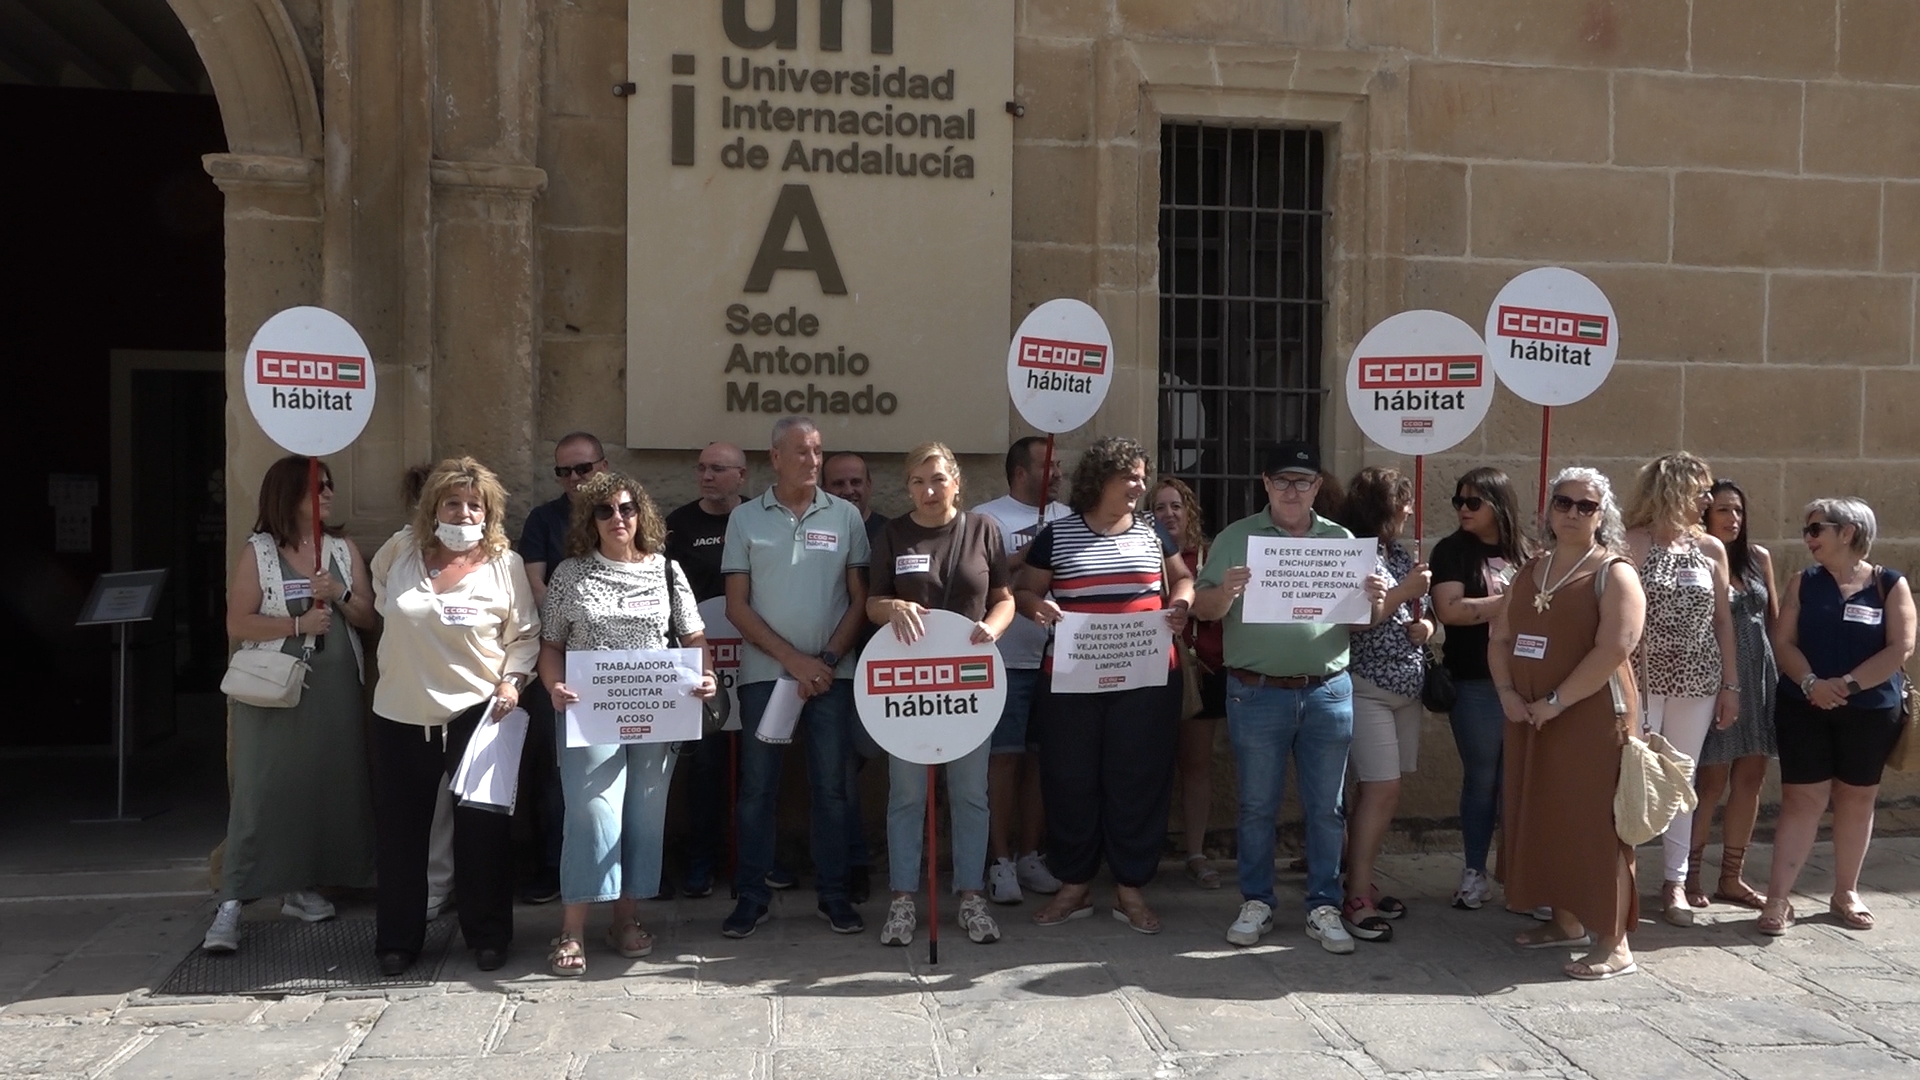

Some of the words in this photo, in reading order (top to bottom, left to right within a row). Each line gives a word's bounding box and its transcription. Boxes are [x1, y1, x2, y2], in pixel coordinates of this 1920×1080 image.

[722, 56, 954, 101] Universidad
[672, 54, 695, 166] i
[722, 96, 976, 140] Internacional
[721, 137, 769, 169] de
[781, 139, 975, 179] Andalucía
[743, 183, 848, 295] A
[725, 303, 820, 337] Sede
[1503, 312, 1574, 337] CCOO
[724, 343, 870, 376] Antonio
[1022, 343, 1081, 366] CCOO
[1509, 339, 1592, 366] hábitat
[262, 358, 333, 380] CCOO
[1364, 362, 1443, 382] CCOO
[1026, 369, 1092, 394] hábitat
[272, 387, 352, 411] hábitat
[726, 381, 898, 415] Machado
[1374, 390, 1465, 411] hábitat
[1280, 548, 1301, 556] ESTE
[1265, 569, 1329, 578] DESIGUALDAD
[1279, 559, 1338, 567] ENCHUFISMO
[1260, 580, 1290, 588] TRATO
[1291, 580, 1309, 588] DEL
[1312, 581, 1360, 589] PERSONAL
[1281, 591, 1294, 599] DE
[1296, 591, 1336, 599] LIMPIEZA
[1073, 632, 1124, 641] SUPUESTOS
[1125, 629, 1157, 639] TRATOS
[1090, 622, 1119, 631] BASTA
[1068, 651, 1135, 660] TRABAJADORAS
[1076, 642, 1128, 651] VEJATORIOS
[1137, 639, 1153, 647] LAS
[595, 661, 675, 671] TRABAJADORA
[873, 665, 954, 687] CCOO
[1095, 661, 1132, 670] LIMPIEZA
[592, 675, 653, 685] DESPEDIDA
[655, 674, 678, 683] POR
[607, 688, 663, 697] SOLICITAR
[593, 701, 660, 710] PROTOCOLO
[662, 700, 676, 709] DE
[884, 693, 979, 718] hábitat
[616, 714, 654, 723] ACOSO
